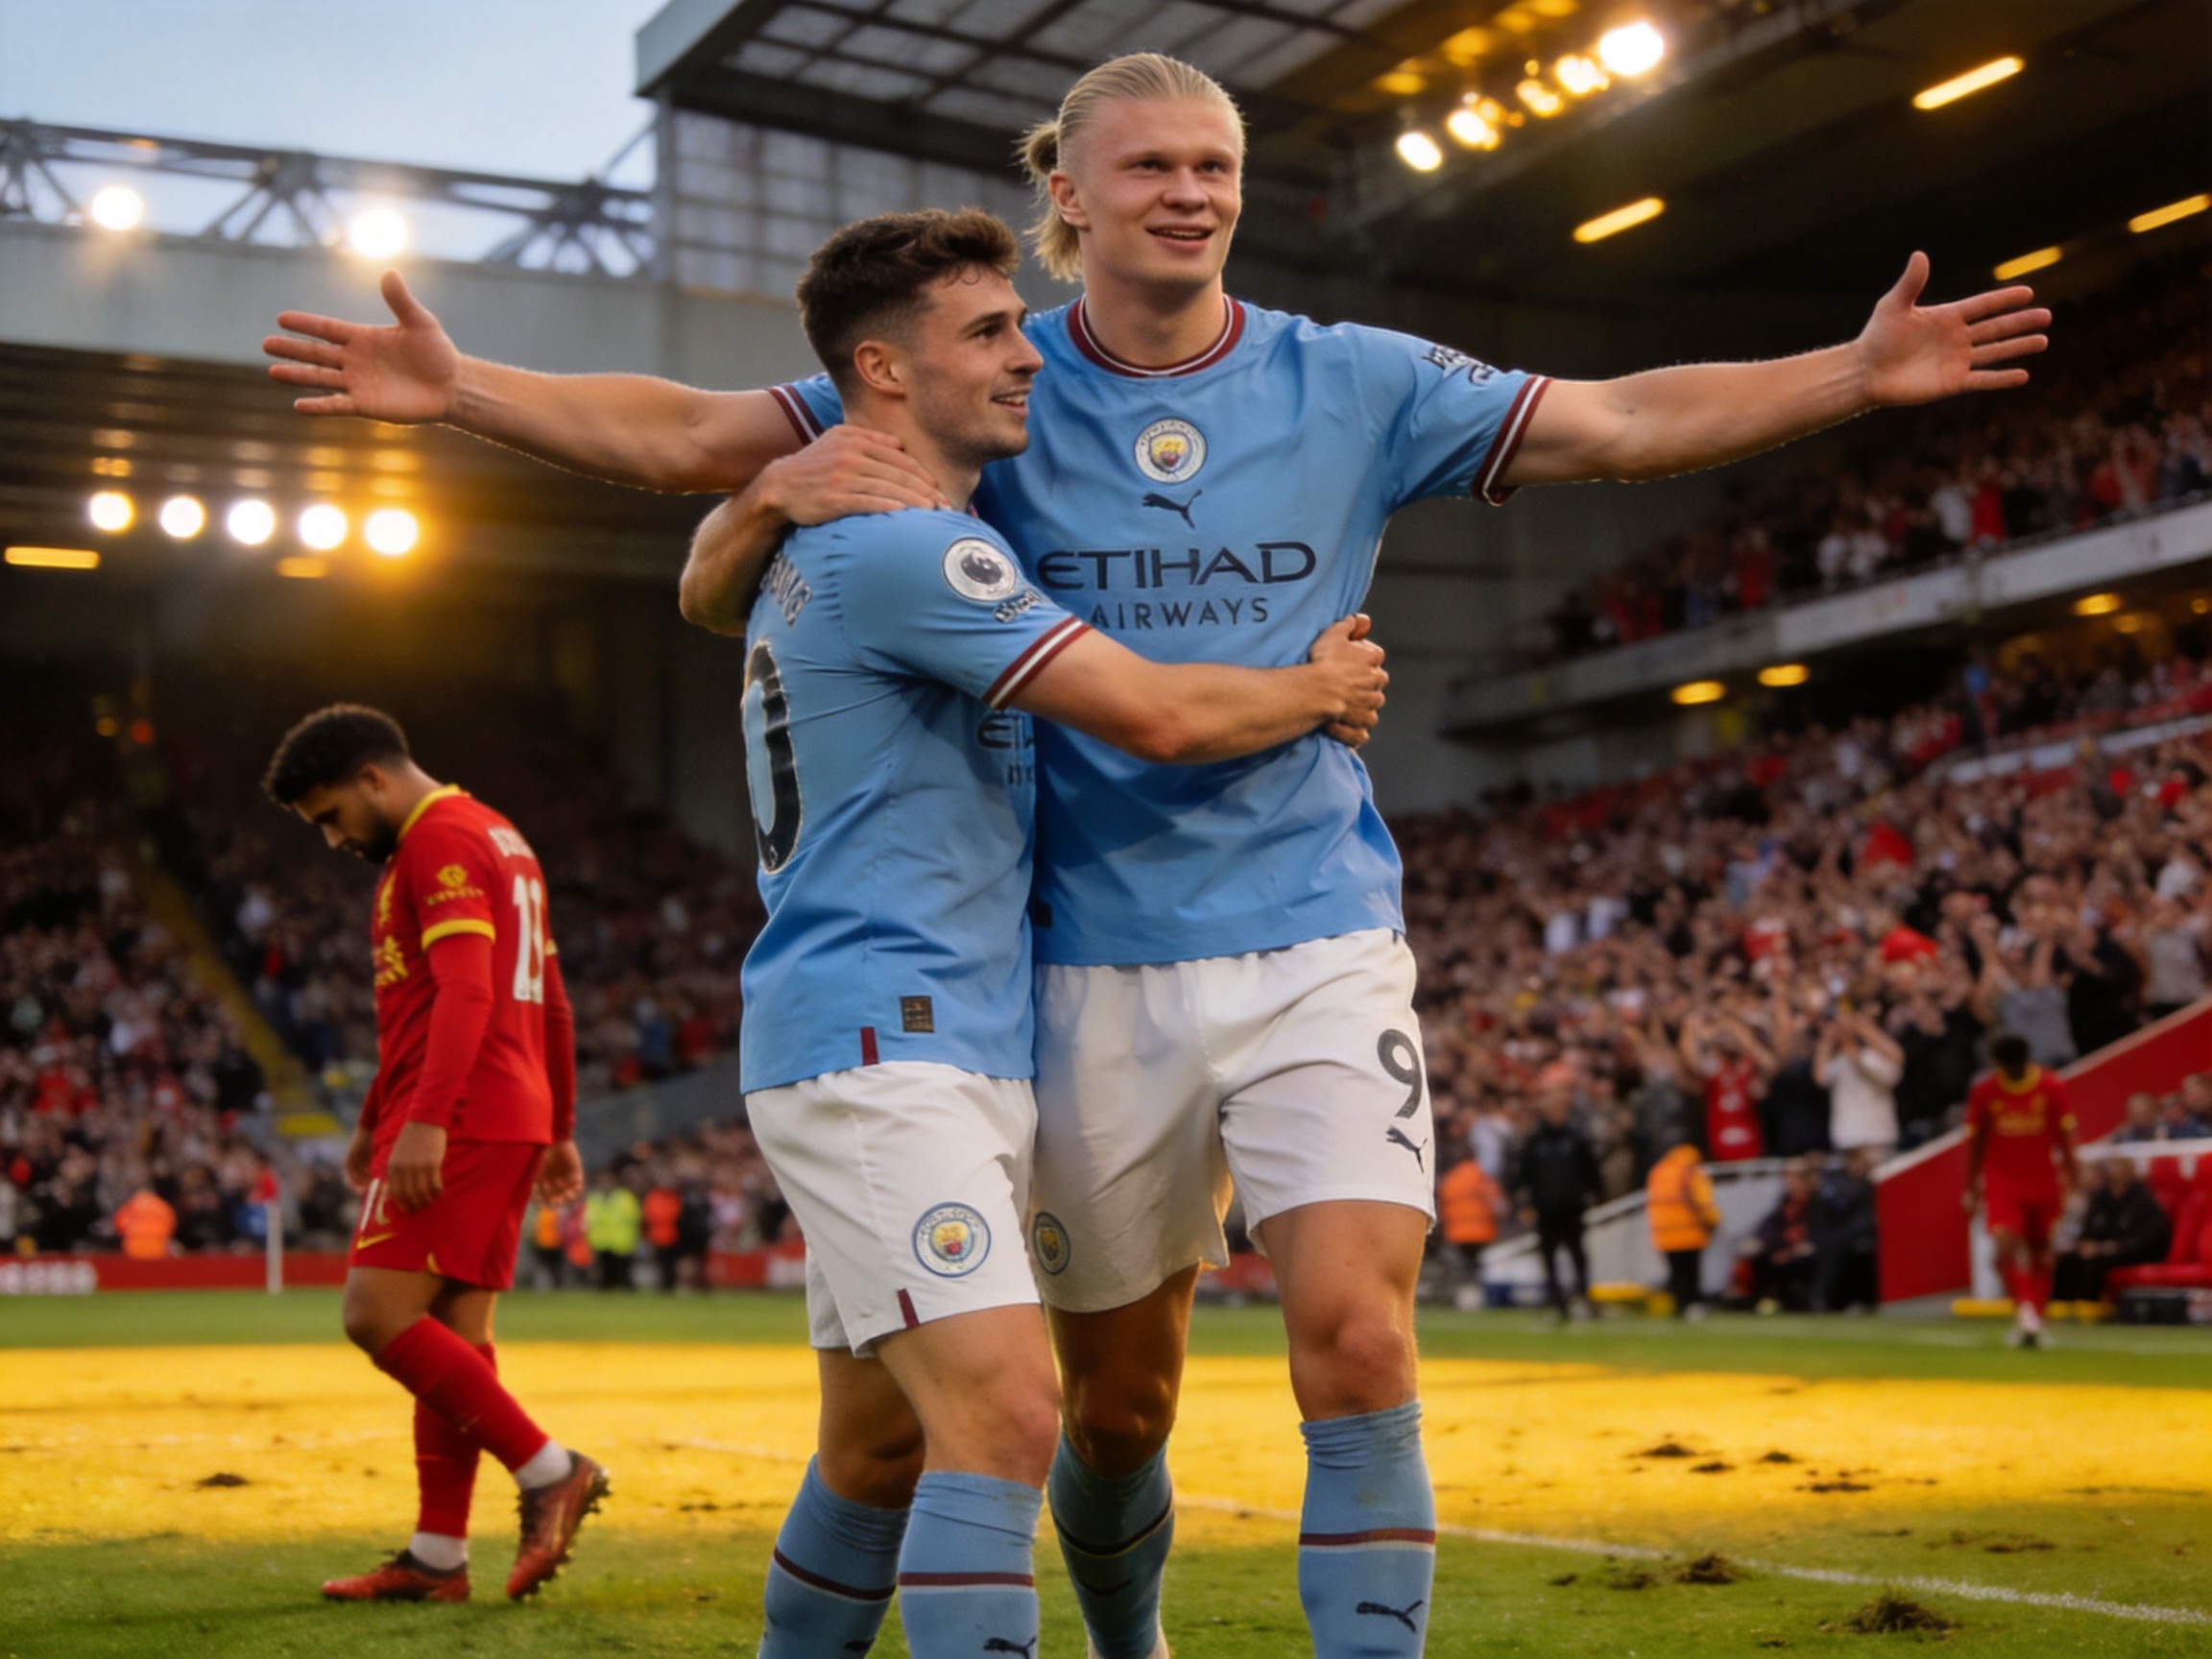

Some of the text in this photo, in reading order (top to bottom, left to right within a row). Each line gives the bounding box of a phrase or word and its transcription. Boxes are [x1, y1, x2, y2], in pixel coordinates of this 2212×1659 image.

[1036, 541, 1317, 590] ETIHAD
[1089, 596, 1269, 630] AIRWAYS
[1376, 1028, 1423, 1119] 9
